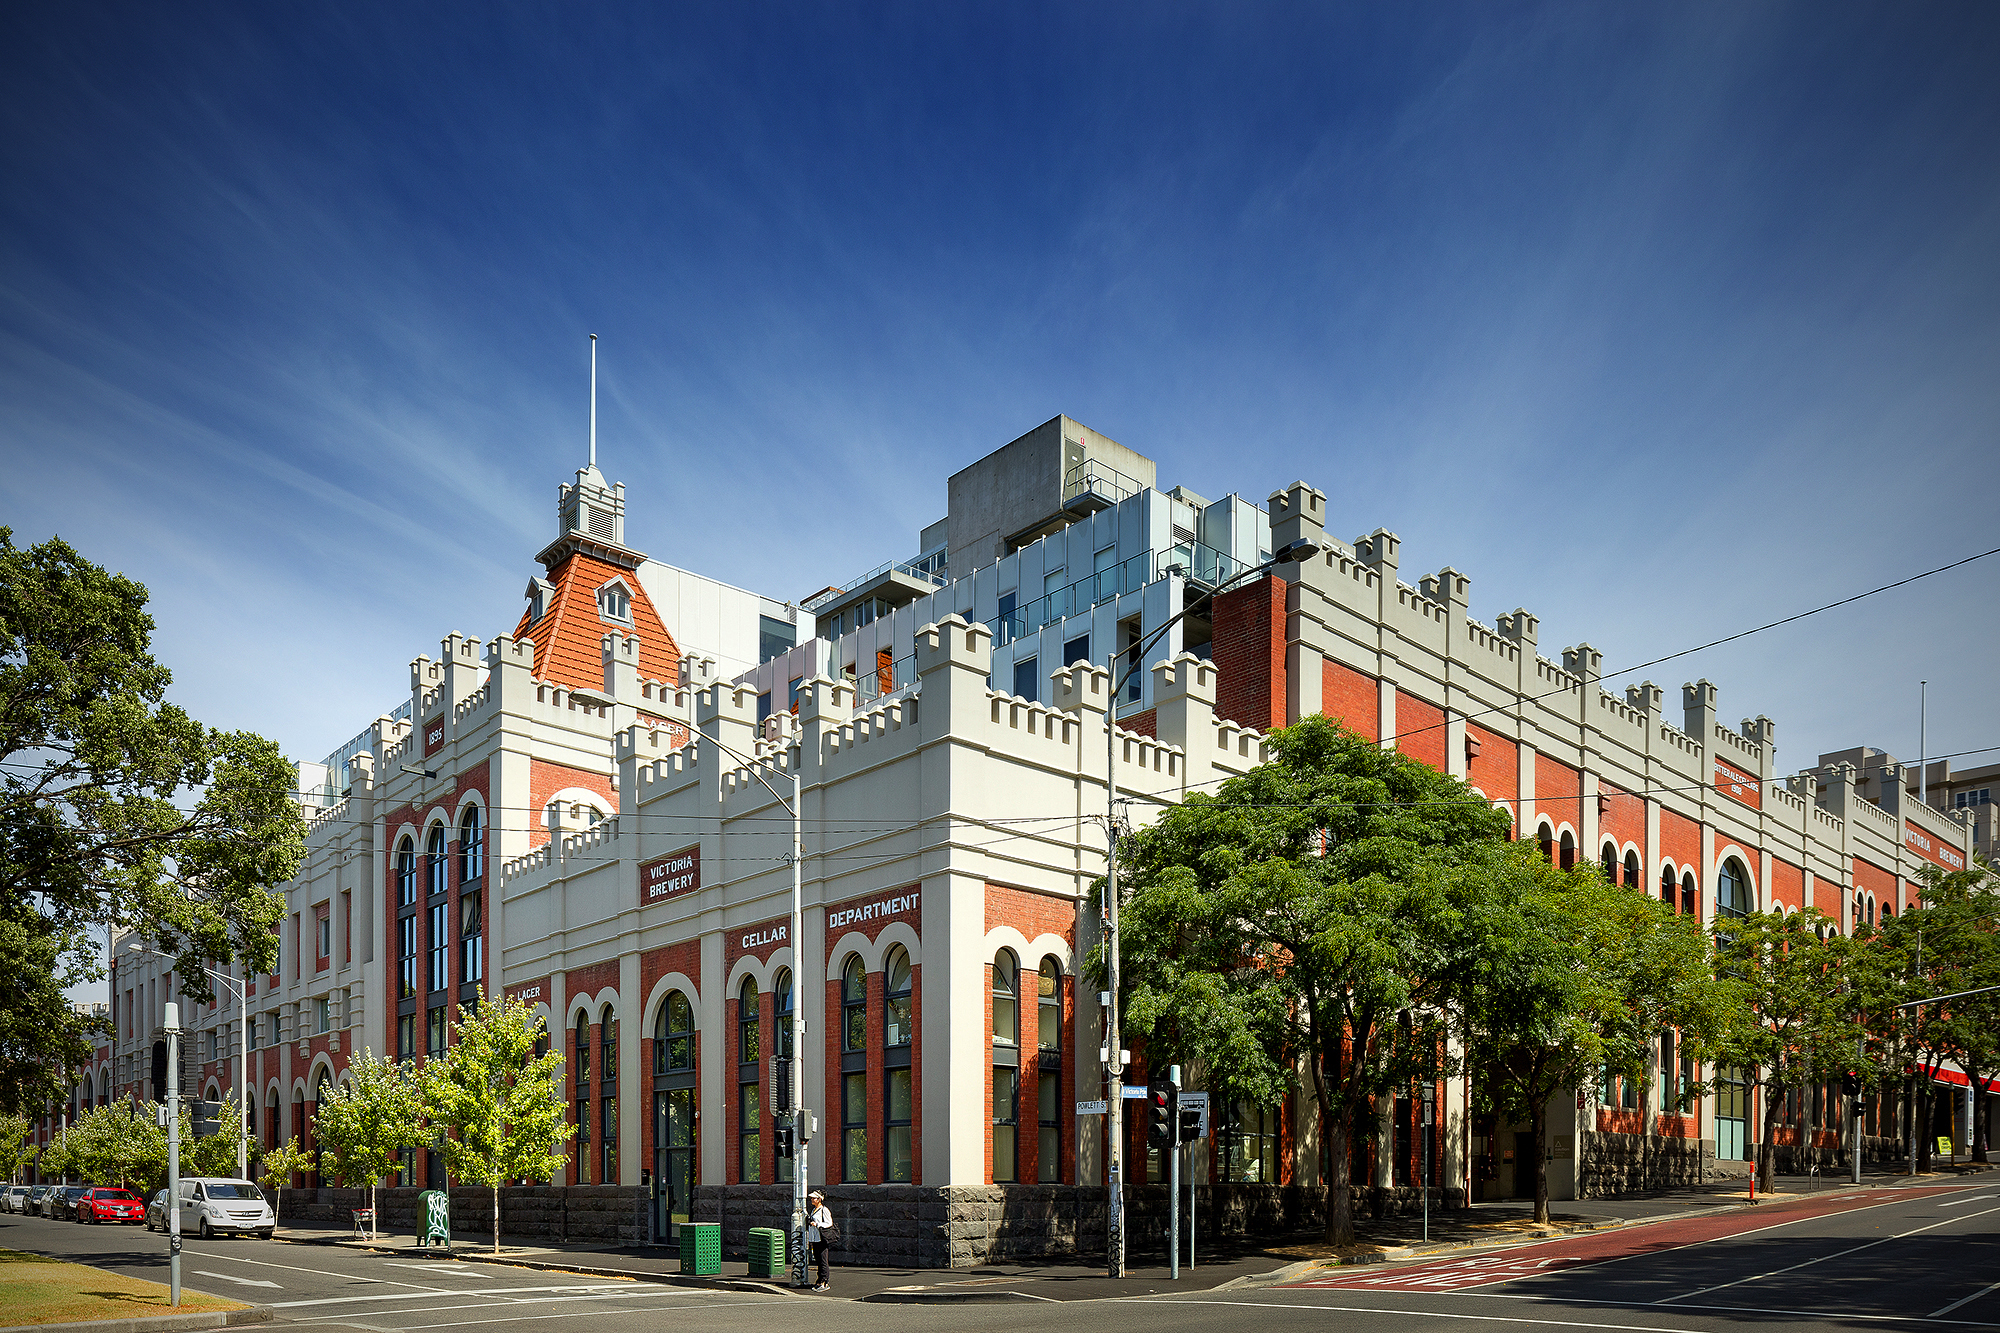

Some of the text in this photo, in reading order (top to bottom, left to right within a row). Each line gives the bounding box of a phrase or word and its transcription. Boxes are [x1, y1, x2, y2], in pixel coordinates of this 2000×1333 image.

[1905, 827, 1964, 870] VICTORIA BREWERY
[650, 855, 693, 879] VICTORIA
[649, 873, 694, 898] BREWERY
[829, 893, 919, 929] DEPARTMENT
[742, 926, 787, 949] CELLAR
[1077, 1101, 1100, 1110] POWLETT
[1422, 1257, 1582, 1270] BUS
